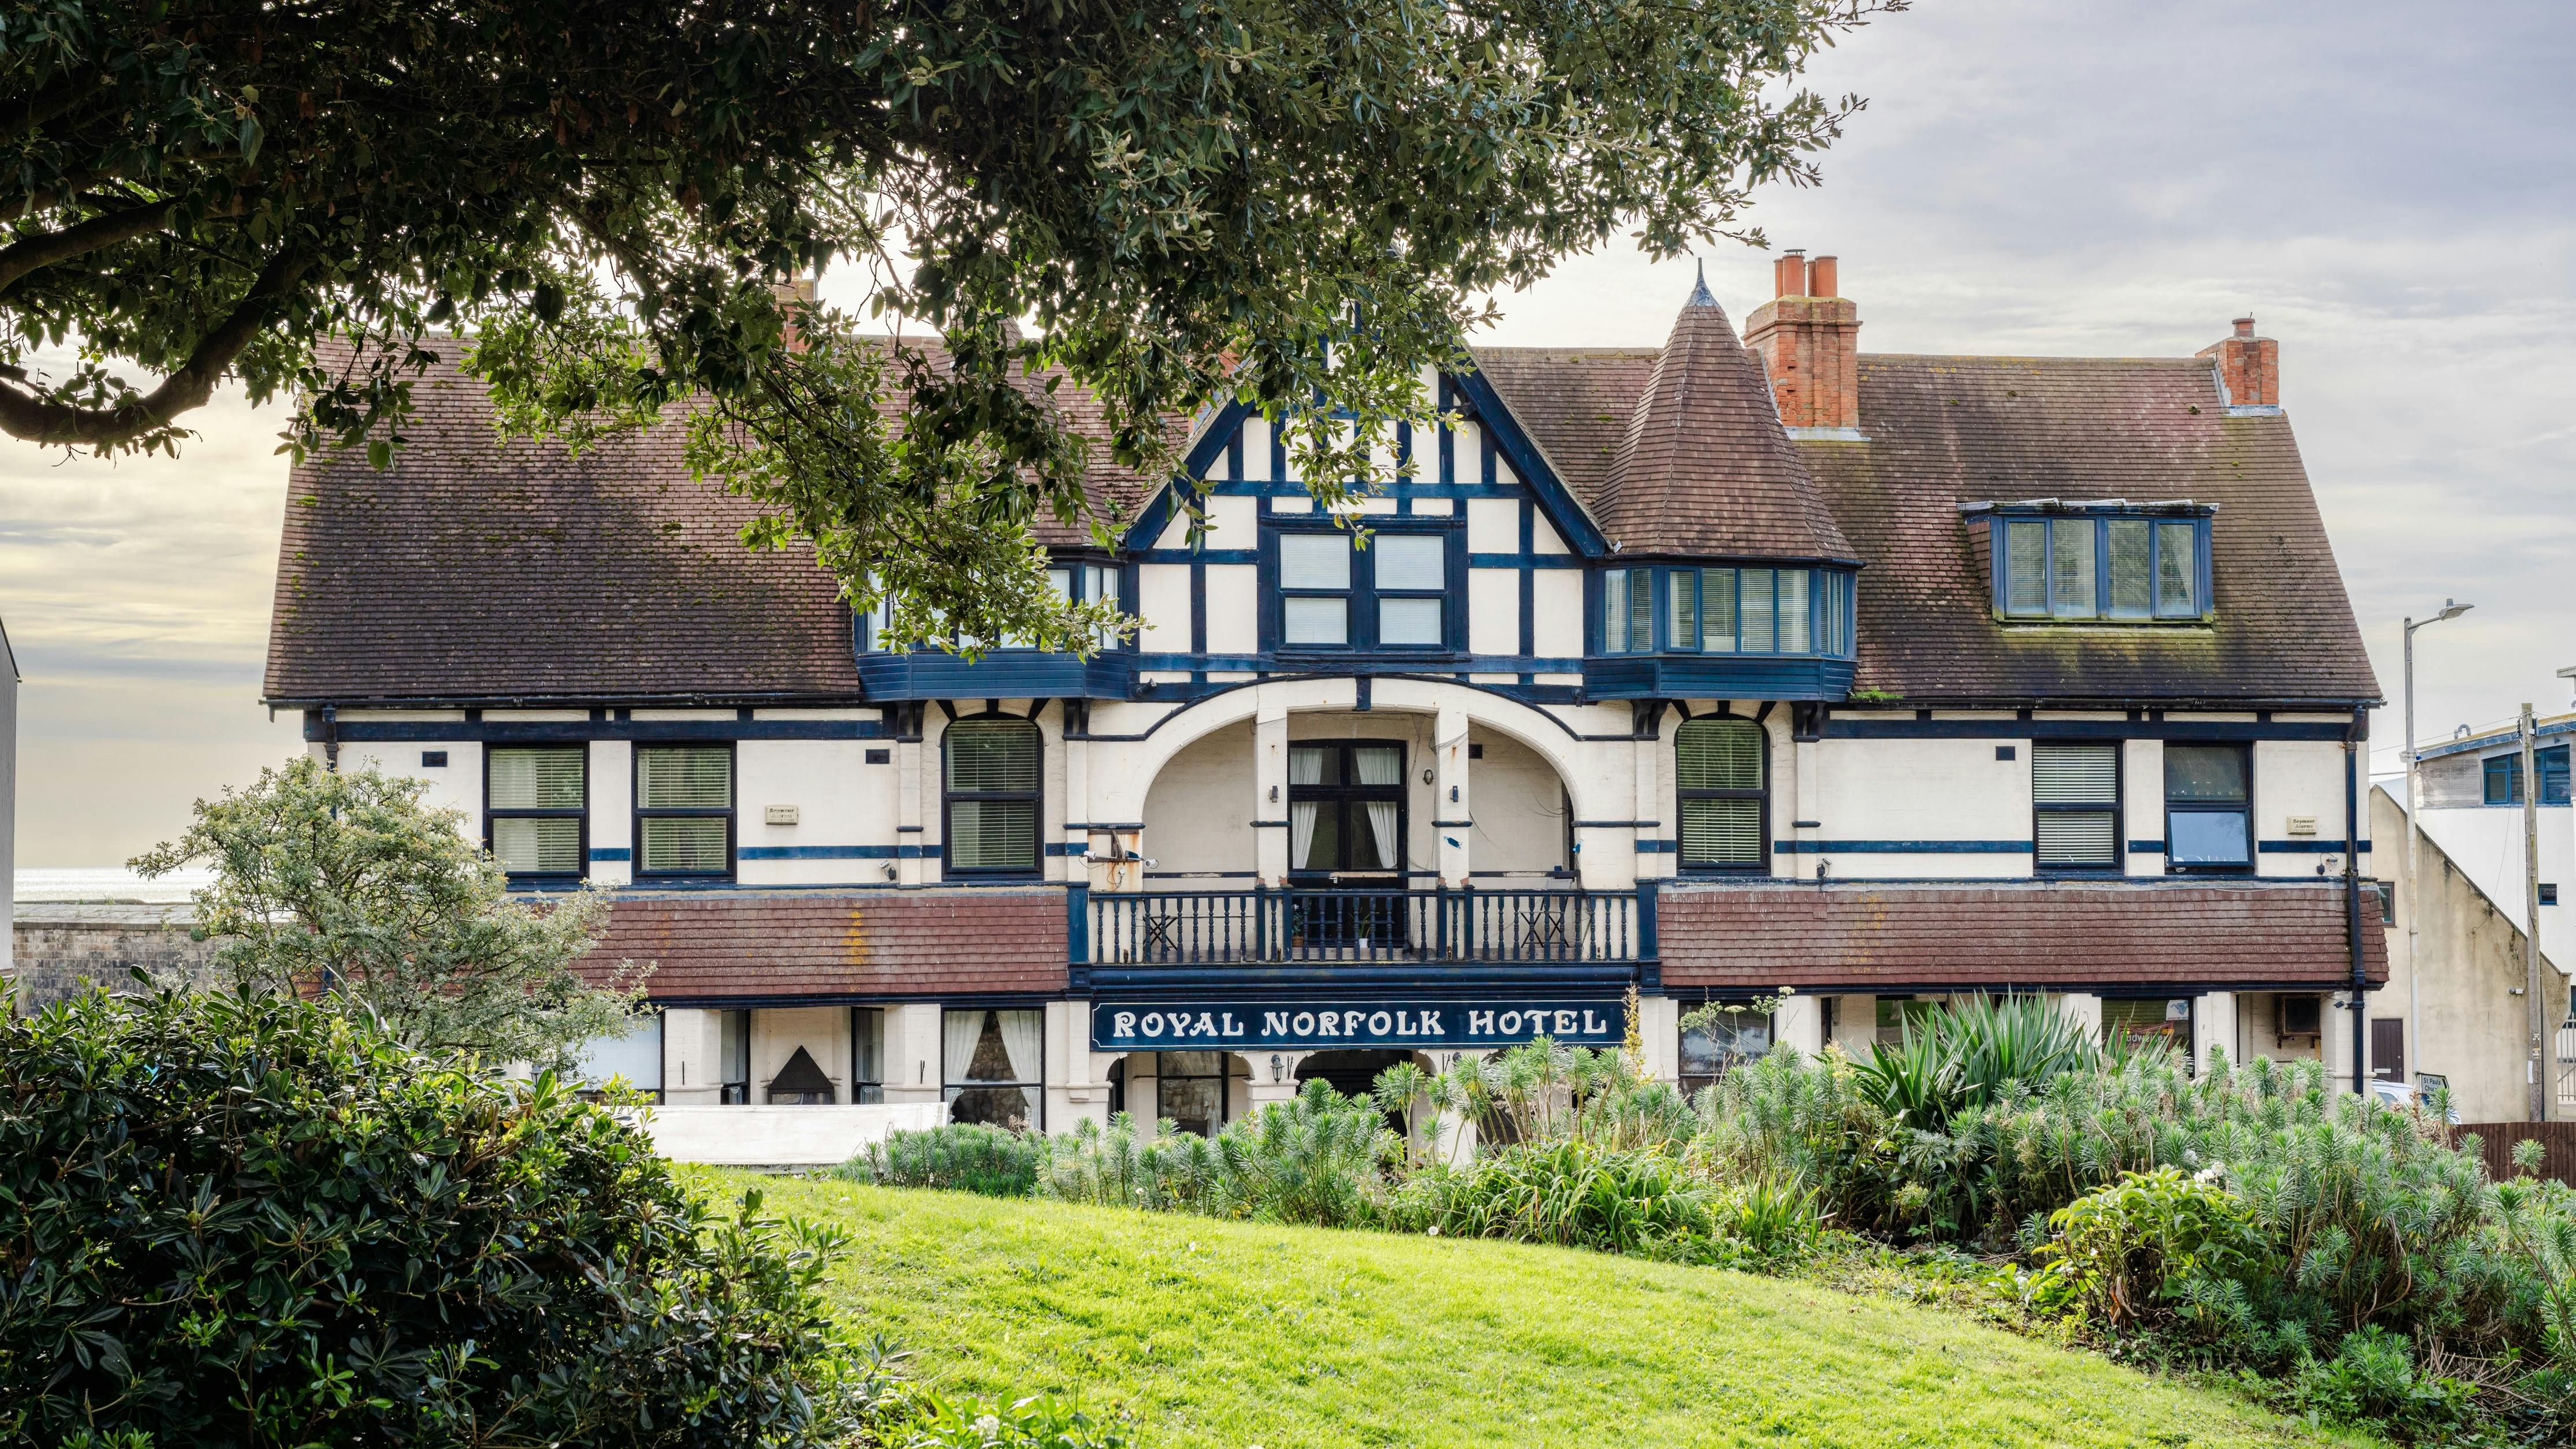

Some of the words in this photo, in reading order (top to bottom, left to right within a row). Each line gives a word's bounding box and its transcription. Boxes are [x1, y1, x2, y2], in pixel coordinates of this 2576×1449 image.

[1114, 1011, 1244, 1037] ROYAL
[1261, 1011, 1445, 1036] NORFOLK
[1468, 1010, 1607, 1035] HOTEL
